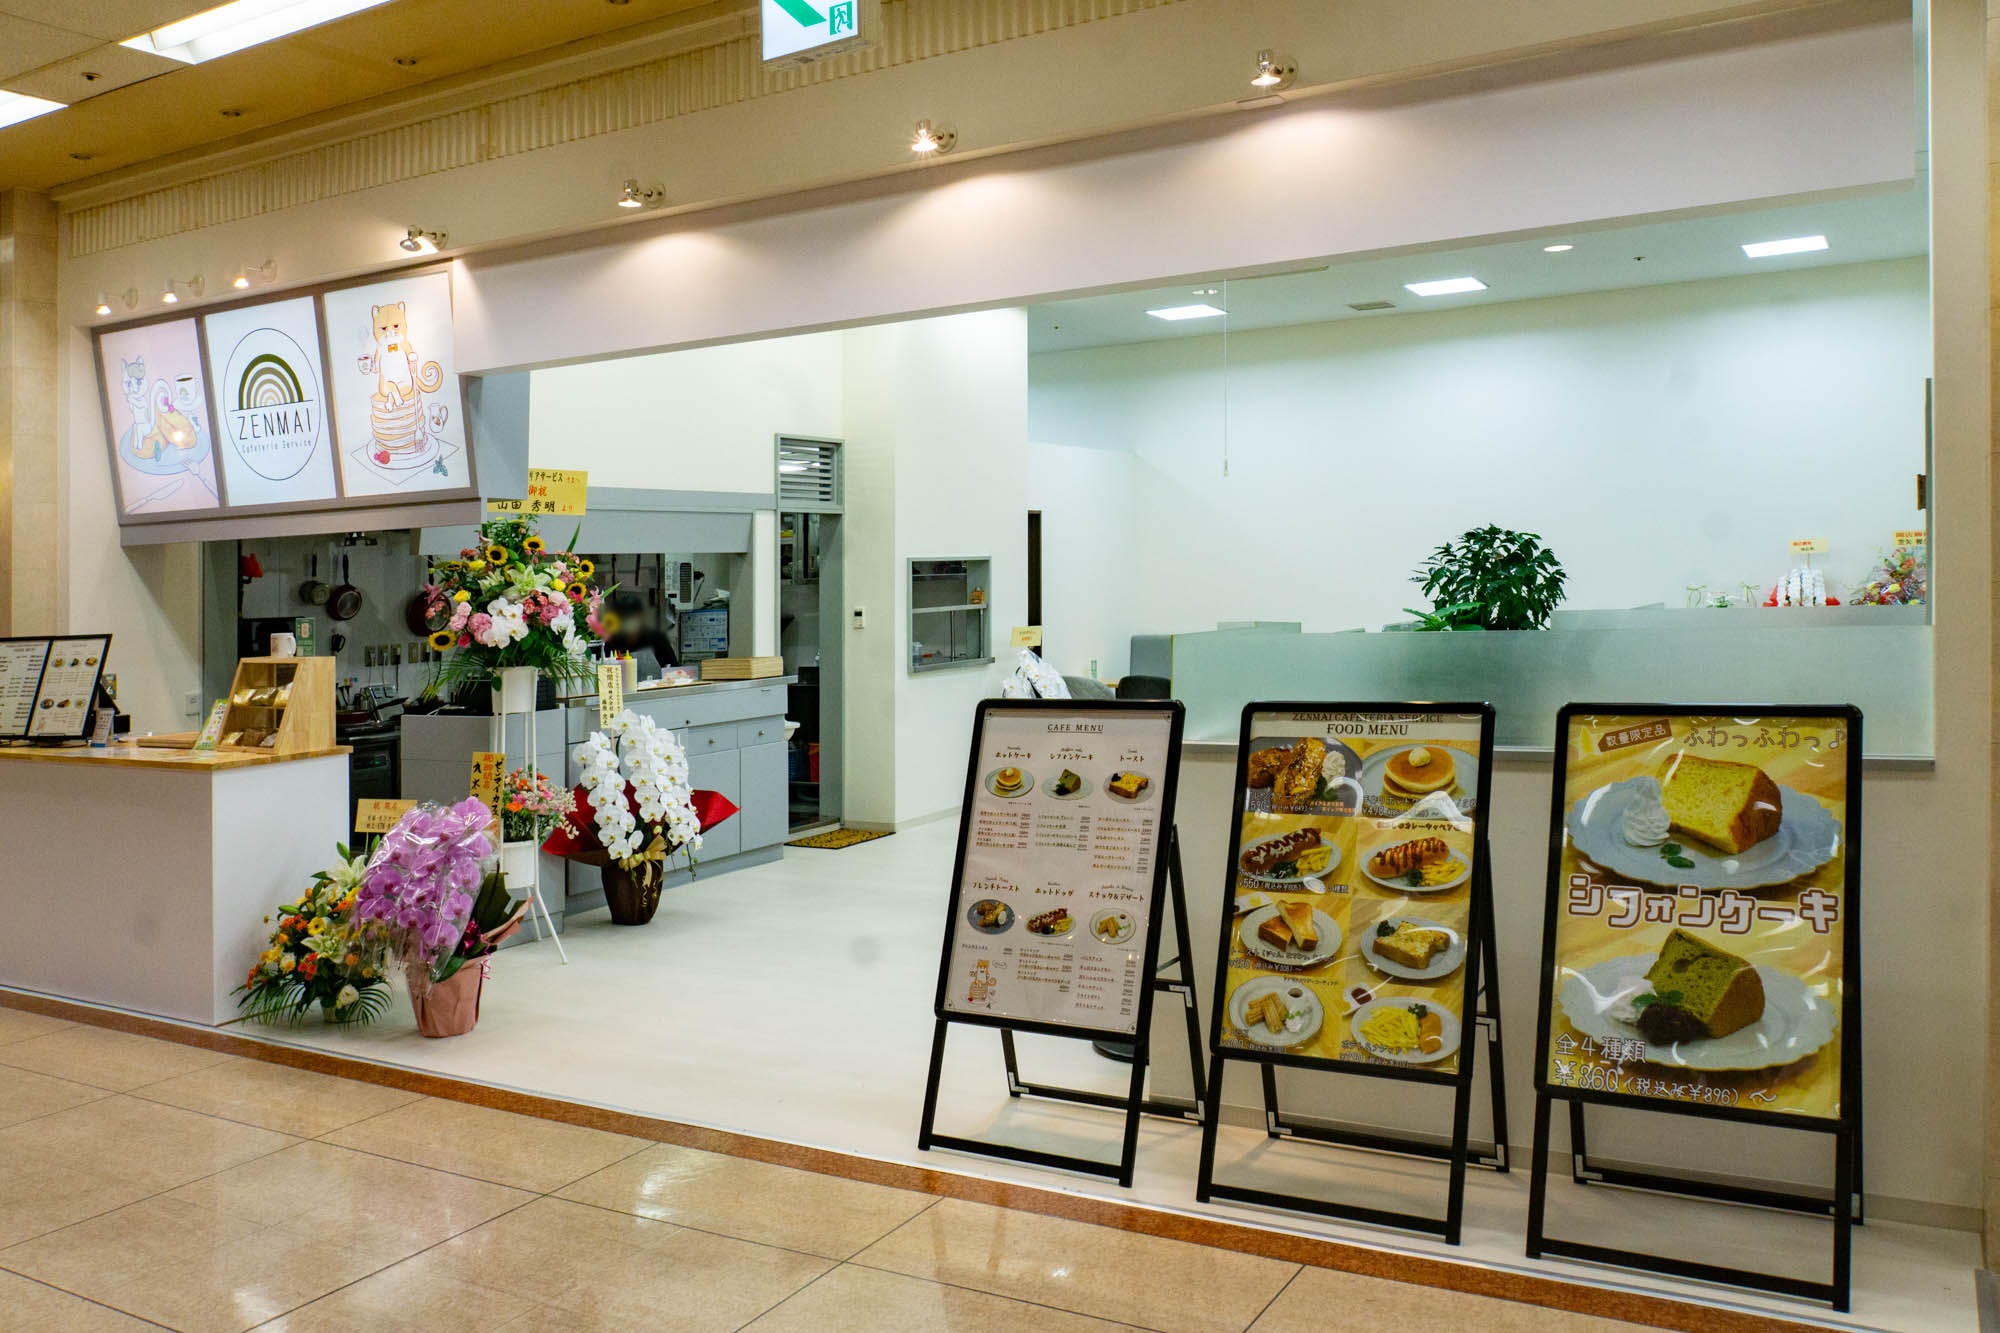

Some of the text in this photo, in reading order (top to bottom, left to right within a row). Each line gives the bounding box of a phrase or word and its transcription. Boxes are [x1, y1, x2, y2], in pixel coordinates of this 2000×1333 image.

[237, 407, 312, 440] ZENMAI
[282, 440, 312, 449] Service
[1292, 712, 1332, 721] ZENMAI
[1048, 723, 1104, 733] CAFE MENU
[1327, 723, 1409, 736] FOOD MENU
[1605, 723, 1667, 747] 数量限定品
[1119, 754, 1145, 763] トースト
[1567, 873, 1840, 935] シフォンケーキ
[1555, 1032, 1646, 1064] 全4種類
